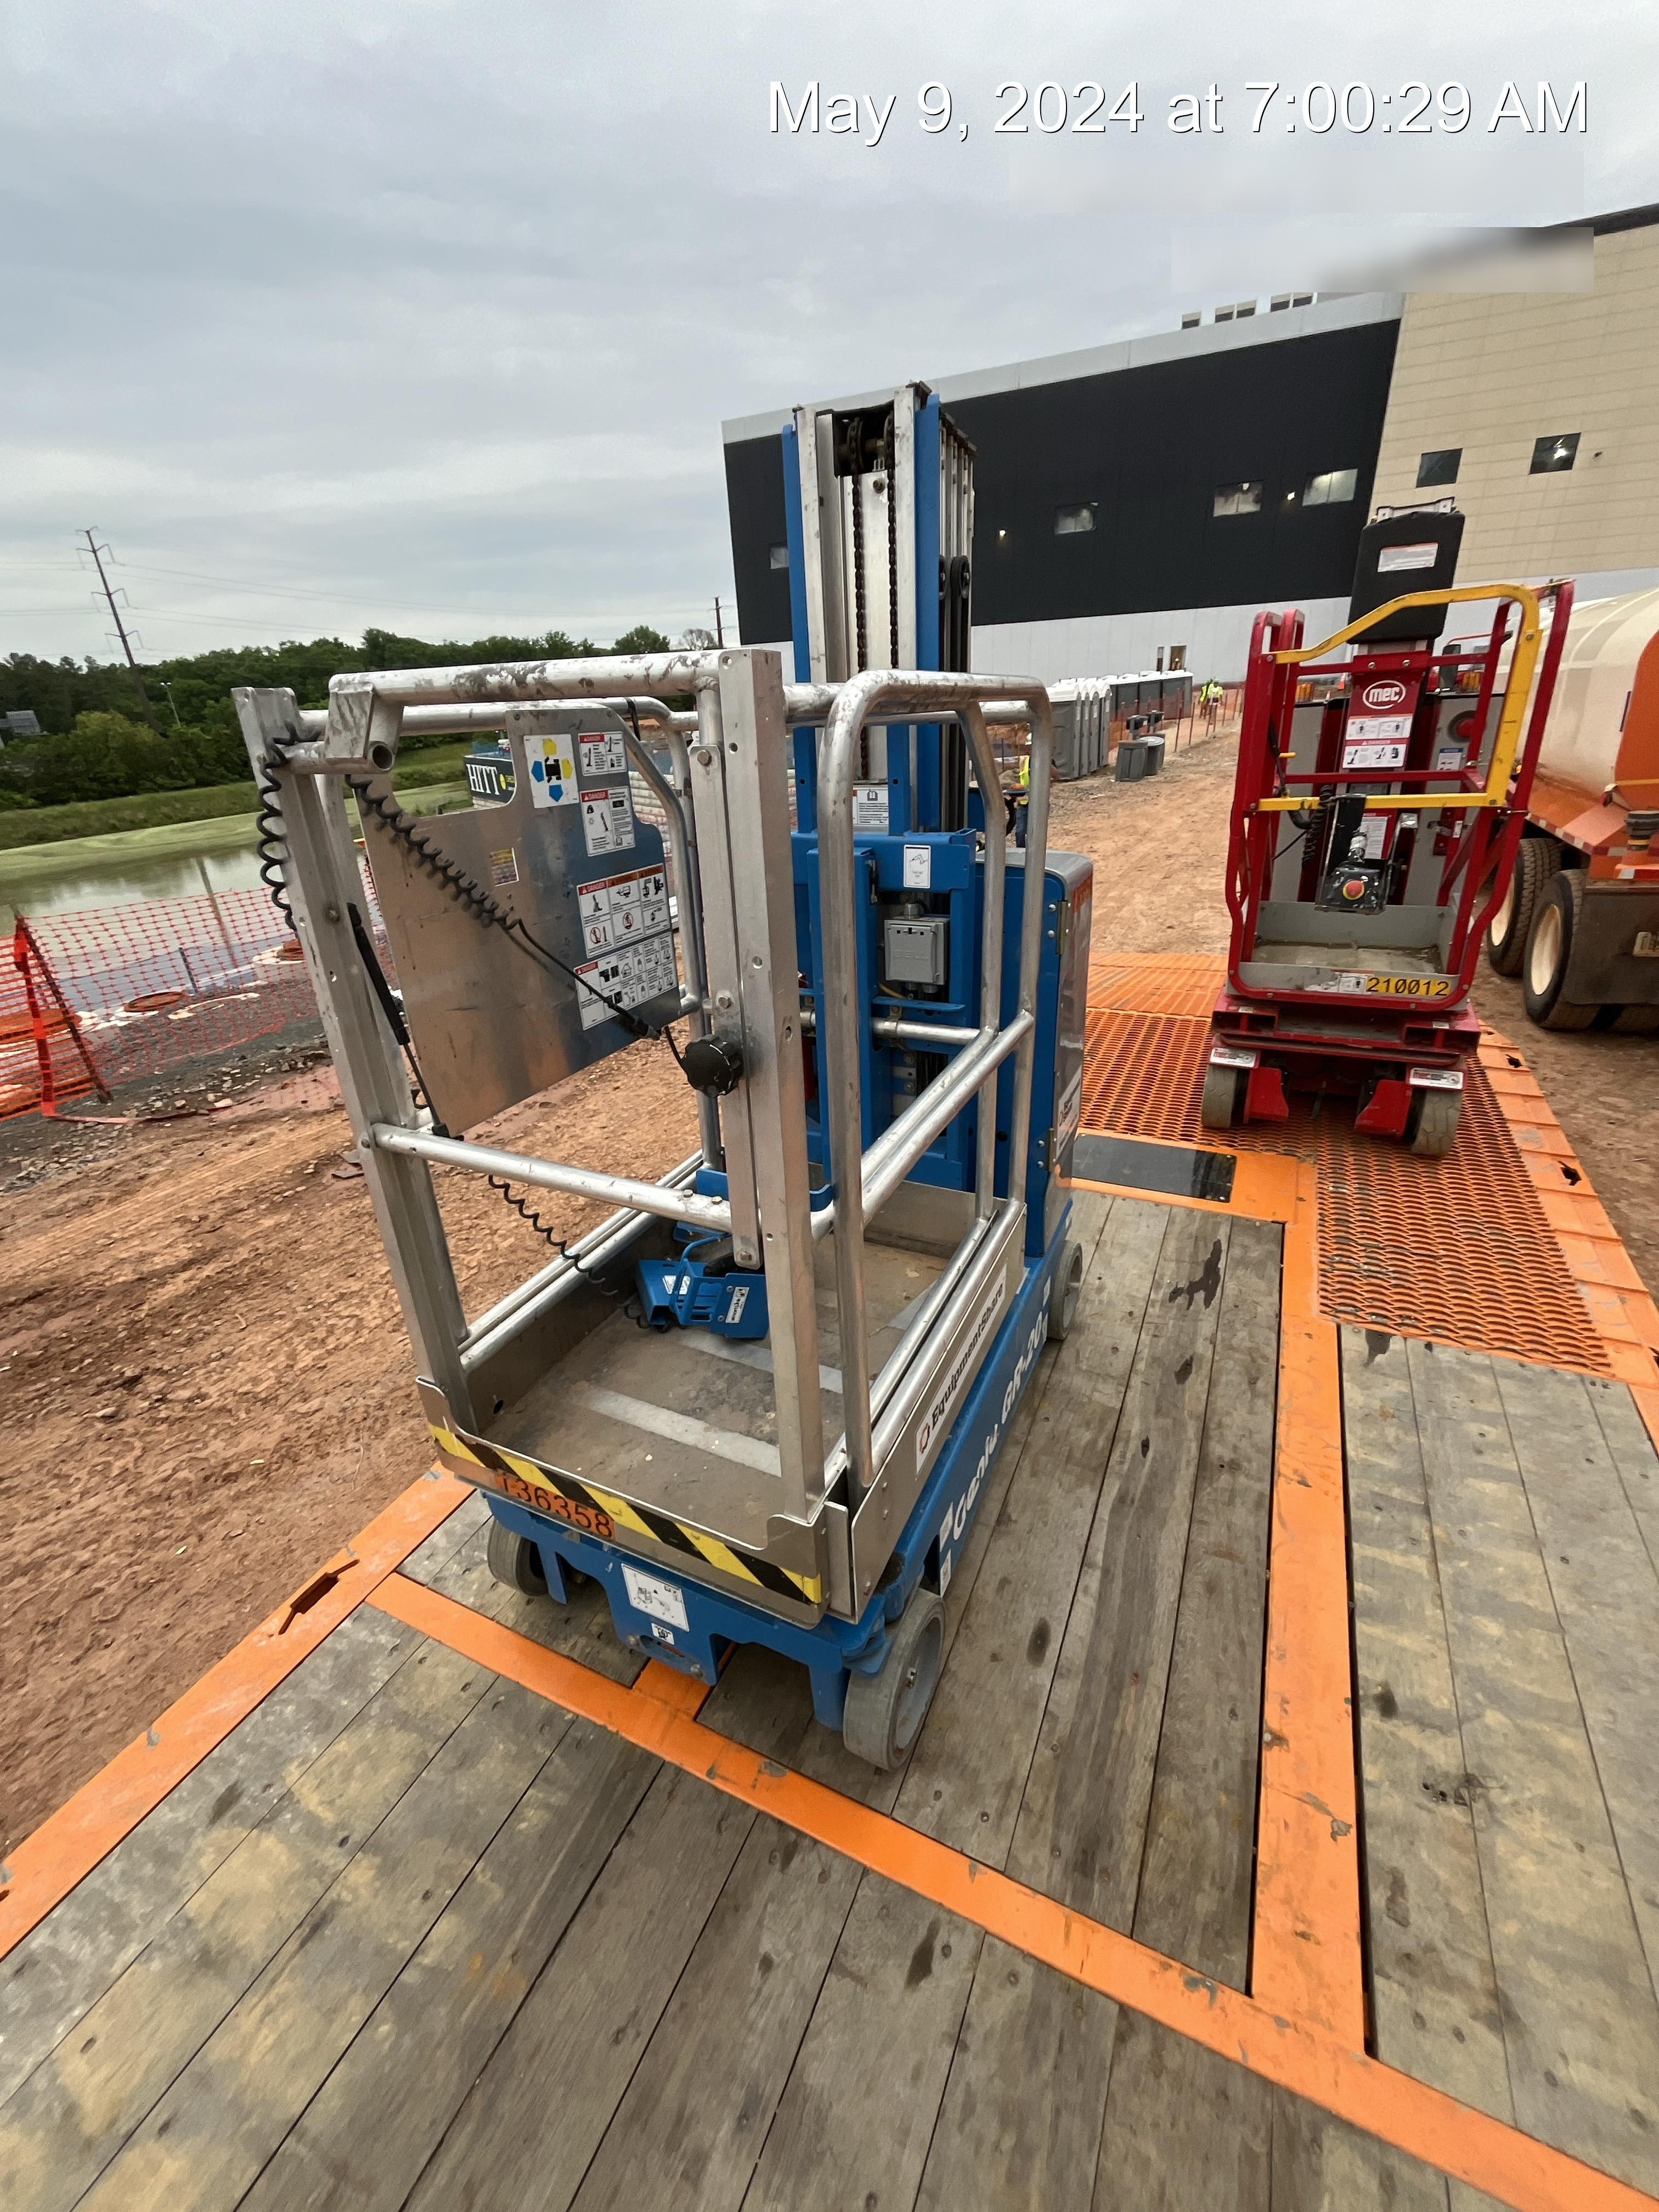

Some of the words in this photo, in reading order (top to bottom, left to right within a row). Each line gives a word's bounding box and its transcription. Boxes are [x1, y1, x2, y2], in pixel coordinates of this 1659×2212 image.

[466, 764, 500, 795] HITT
[1367, 977, 1449, 996] 210012
[932, 1282, 1004, 1431] EquipmentShare
